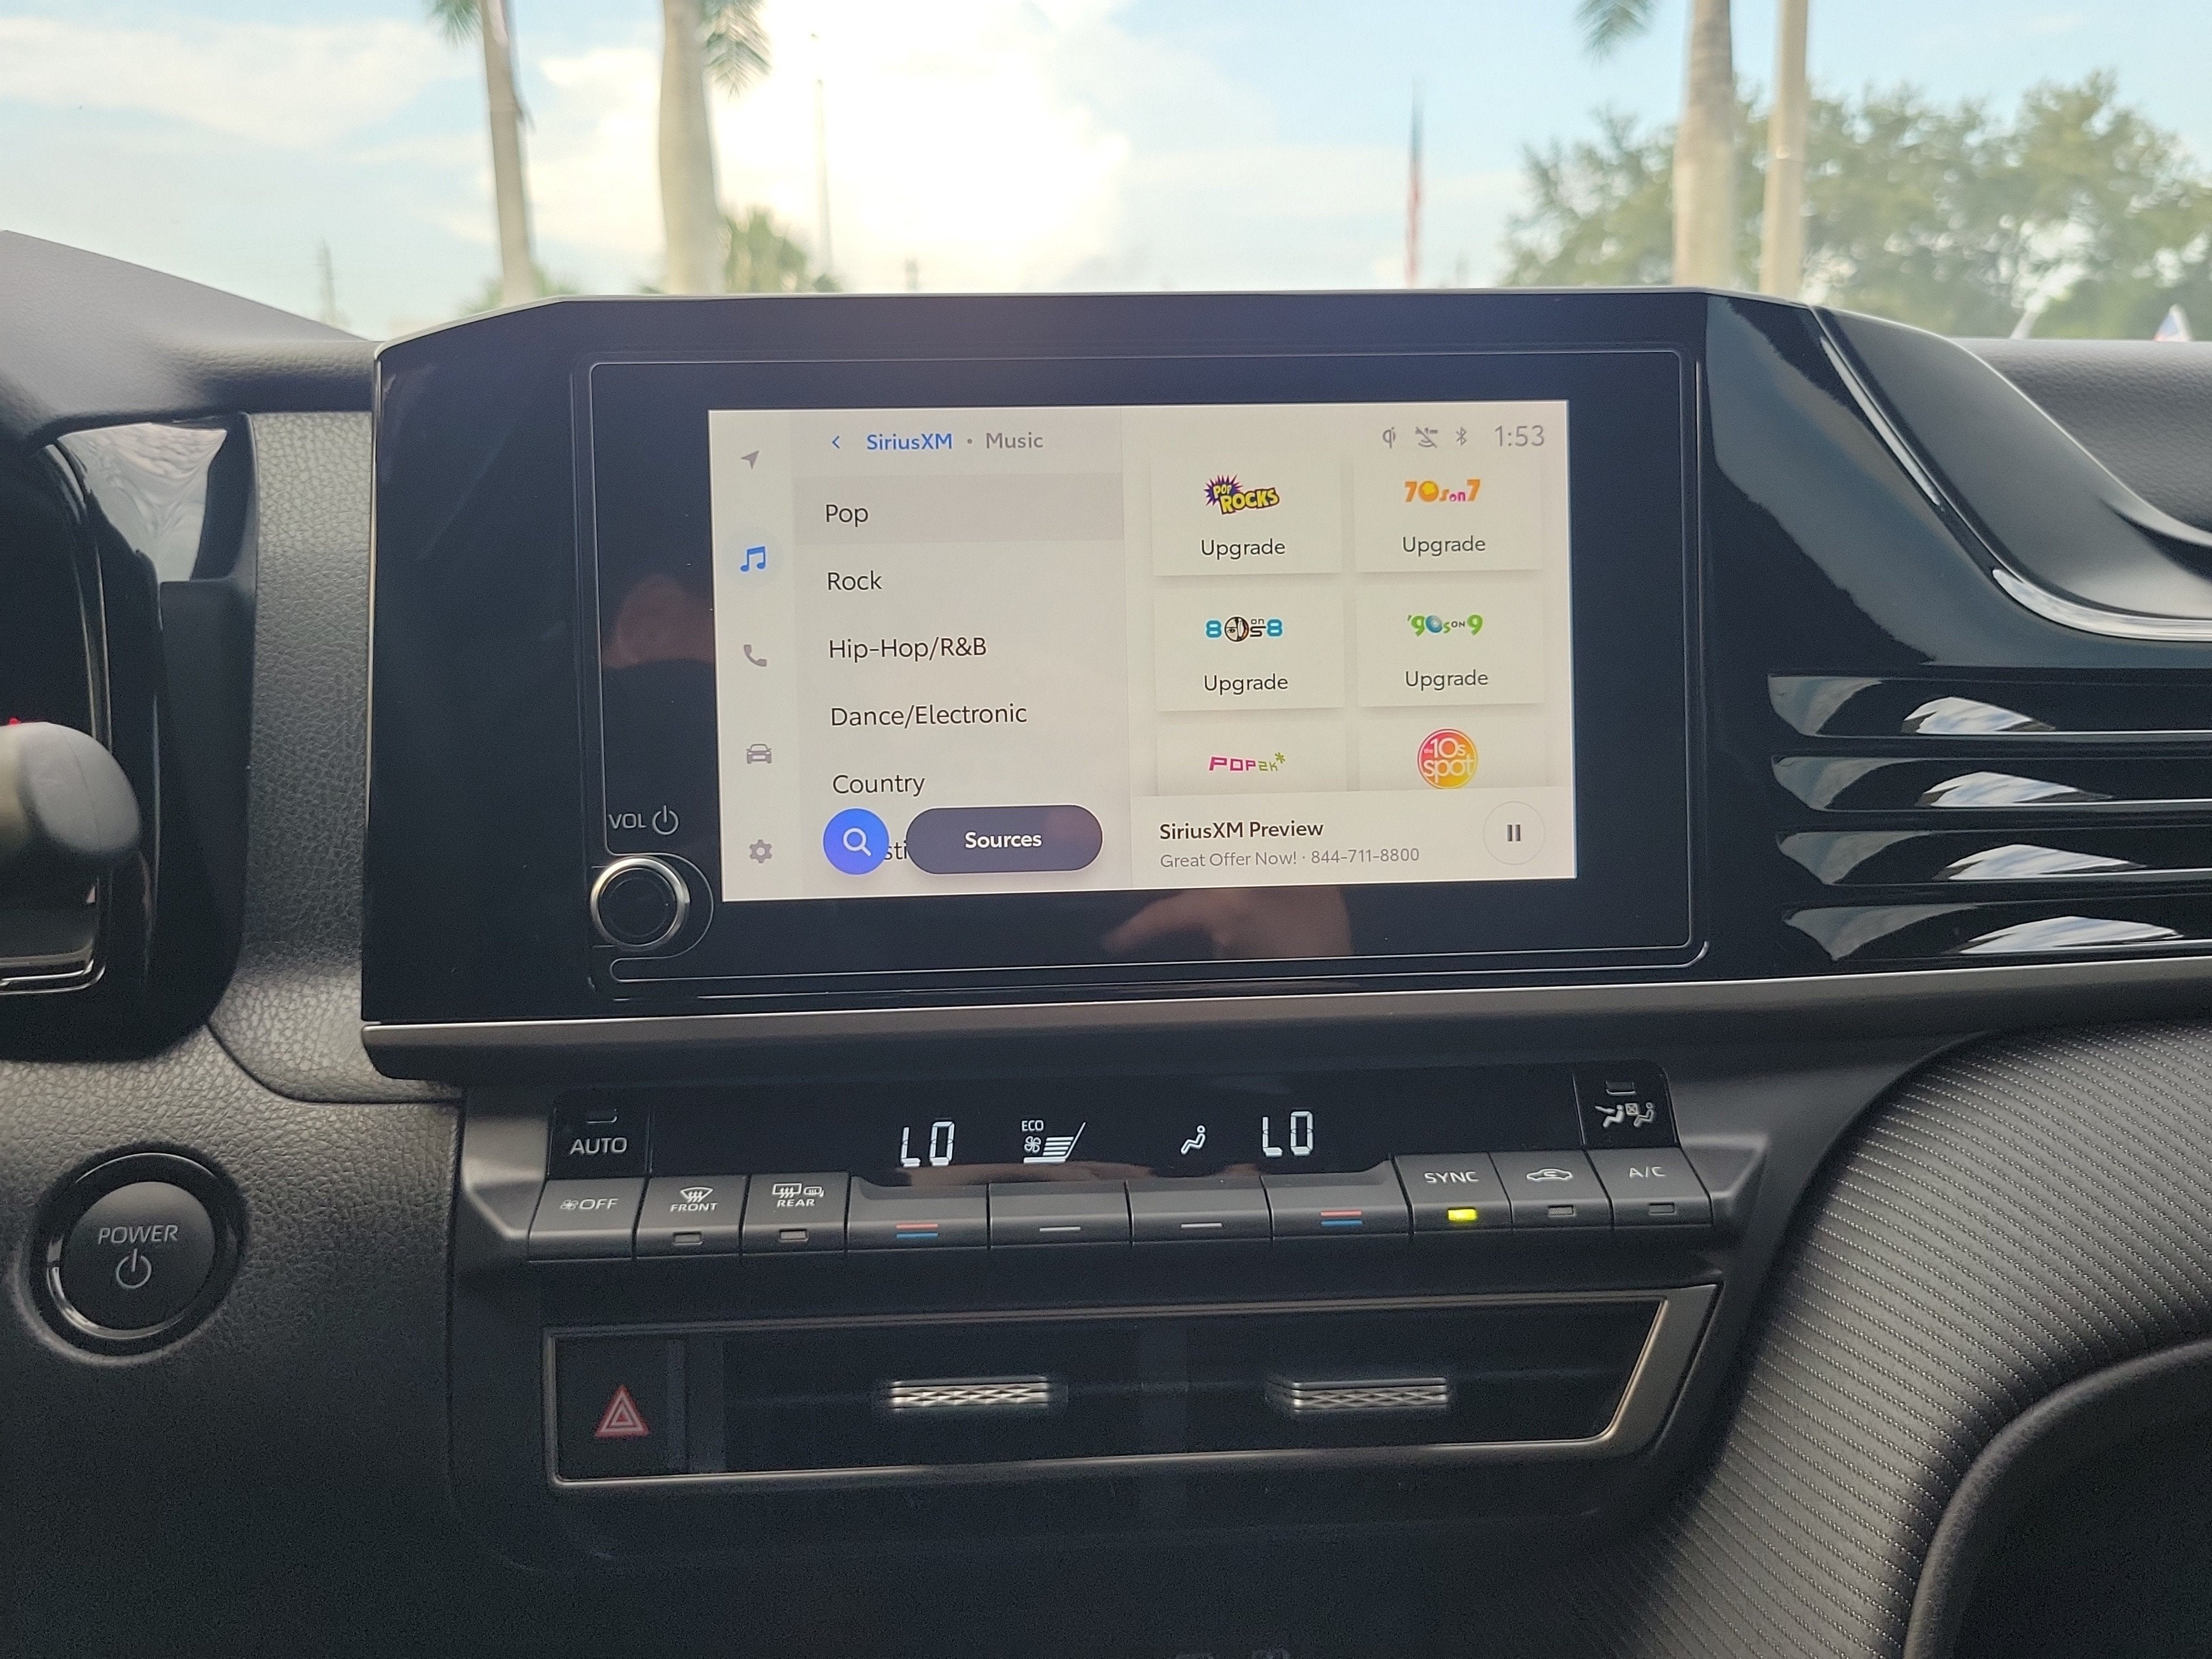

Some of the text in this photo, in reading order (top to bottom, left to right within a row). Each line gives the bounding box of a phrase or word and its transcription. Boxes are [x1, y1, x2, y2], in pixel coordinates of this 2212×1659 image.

[866, 432, 1044, 450] SiriusXM Music
[1494, 425, 1544, 447] 1:53
[1212, 484, 1232, 499] POP
[1220, 488, 1279, 515] ROCKS
[825, 504, 869, 527] Pop
[1201, 539, 1286, 560] Upgrade
[1402, 536, 1486, 556] Upgrade
[827, 571, 883, 591] Rock
[829, 636, 988, 662] Hip-Hop/R&B
[1204, 674, 1289, 695] Upgrade
[1405, 670, 1489, 691] Upgrade
[831, 703, 1028, 729] Dance/Electronic
[1423, 753, 1475, 784] spot
[832, 774, 926, 797] Country
[608, 813, 647, 830] VOL
[1159, 820, 1324, 840] SiriusXM Preview
[964, 832, 1042, 850] Sources
[1160, 848, 1420, 868] Great Offer Now! 844-711-8800
[1021, 1119, 1044, 1132] ECO
[569, 1136, 628, 1155] AUTO
[1424, 1172, 1480, 1184] SYNC
[1629, 1166, 1665, 1178] A/C
[579, 1198, 619, 1210] OFF
[670, 1203, 718, 1212] FRONT
[776, 1198, 815, 1207] REAR
[98, 1224, 179, 1245] POWER
